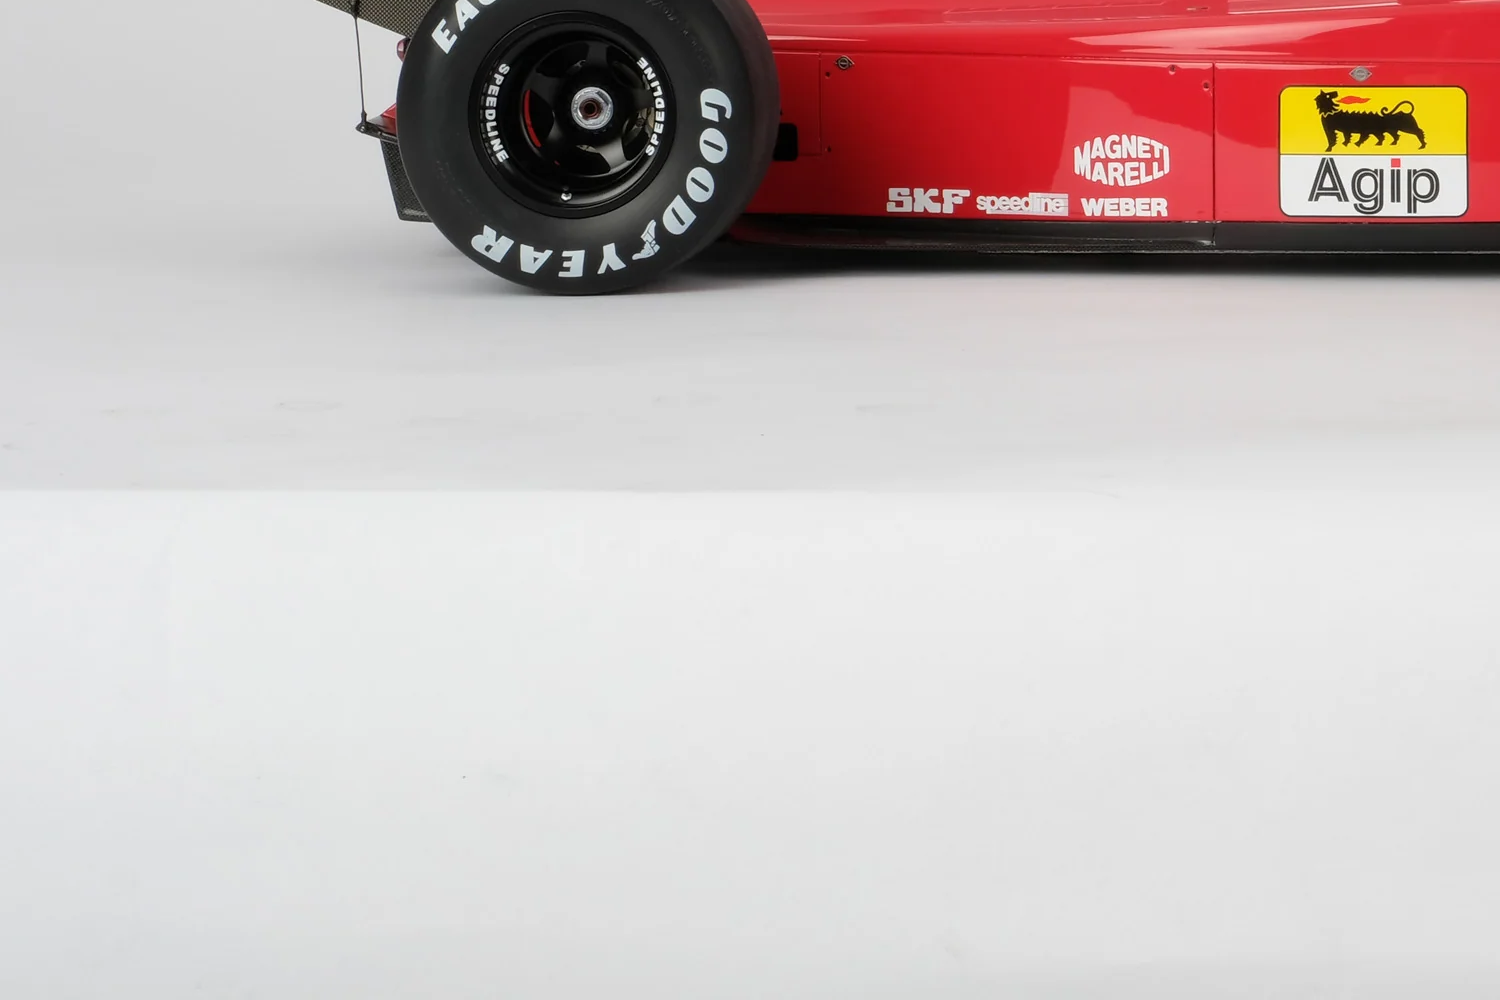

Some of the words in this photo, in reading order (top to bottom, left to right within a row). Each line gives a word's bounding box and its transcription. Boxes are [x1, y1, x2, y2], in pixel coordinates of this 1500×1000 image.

[485, 63, 510, 163] SPEEDLINE
[637, 56, 665, 156] SPEEDLINE
[886, 187, 970, 213] SKF
[976, 193, 1068, 216] speedline
[1308, 157, 1440, 214] Agip
[1081, 197, 1168, 217] WEBER
